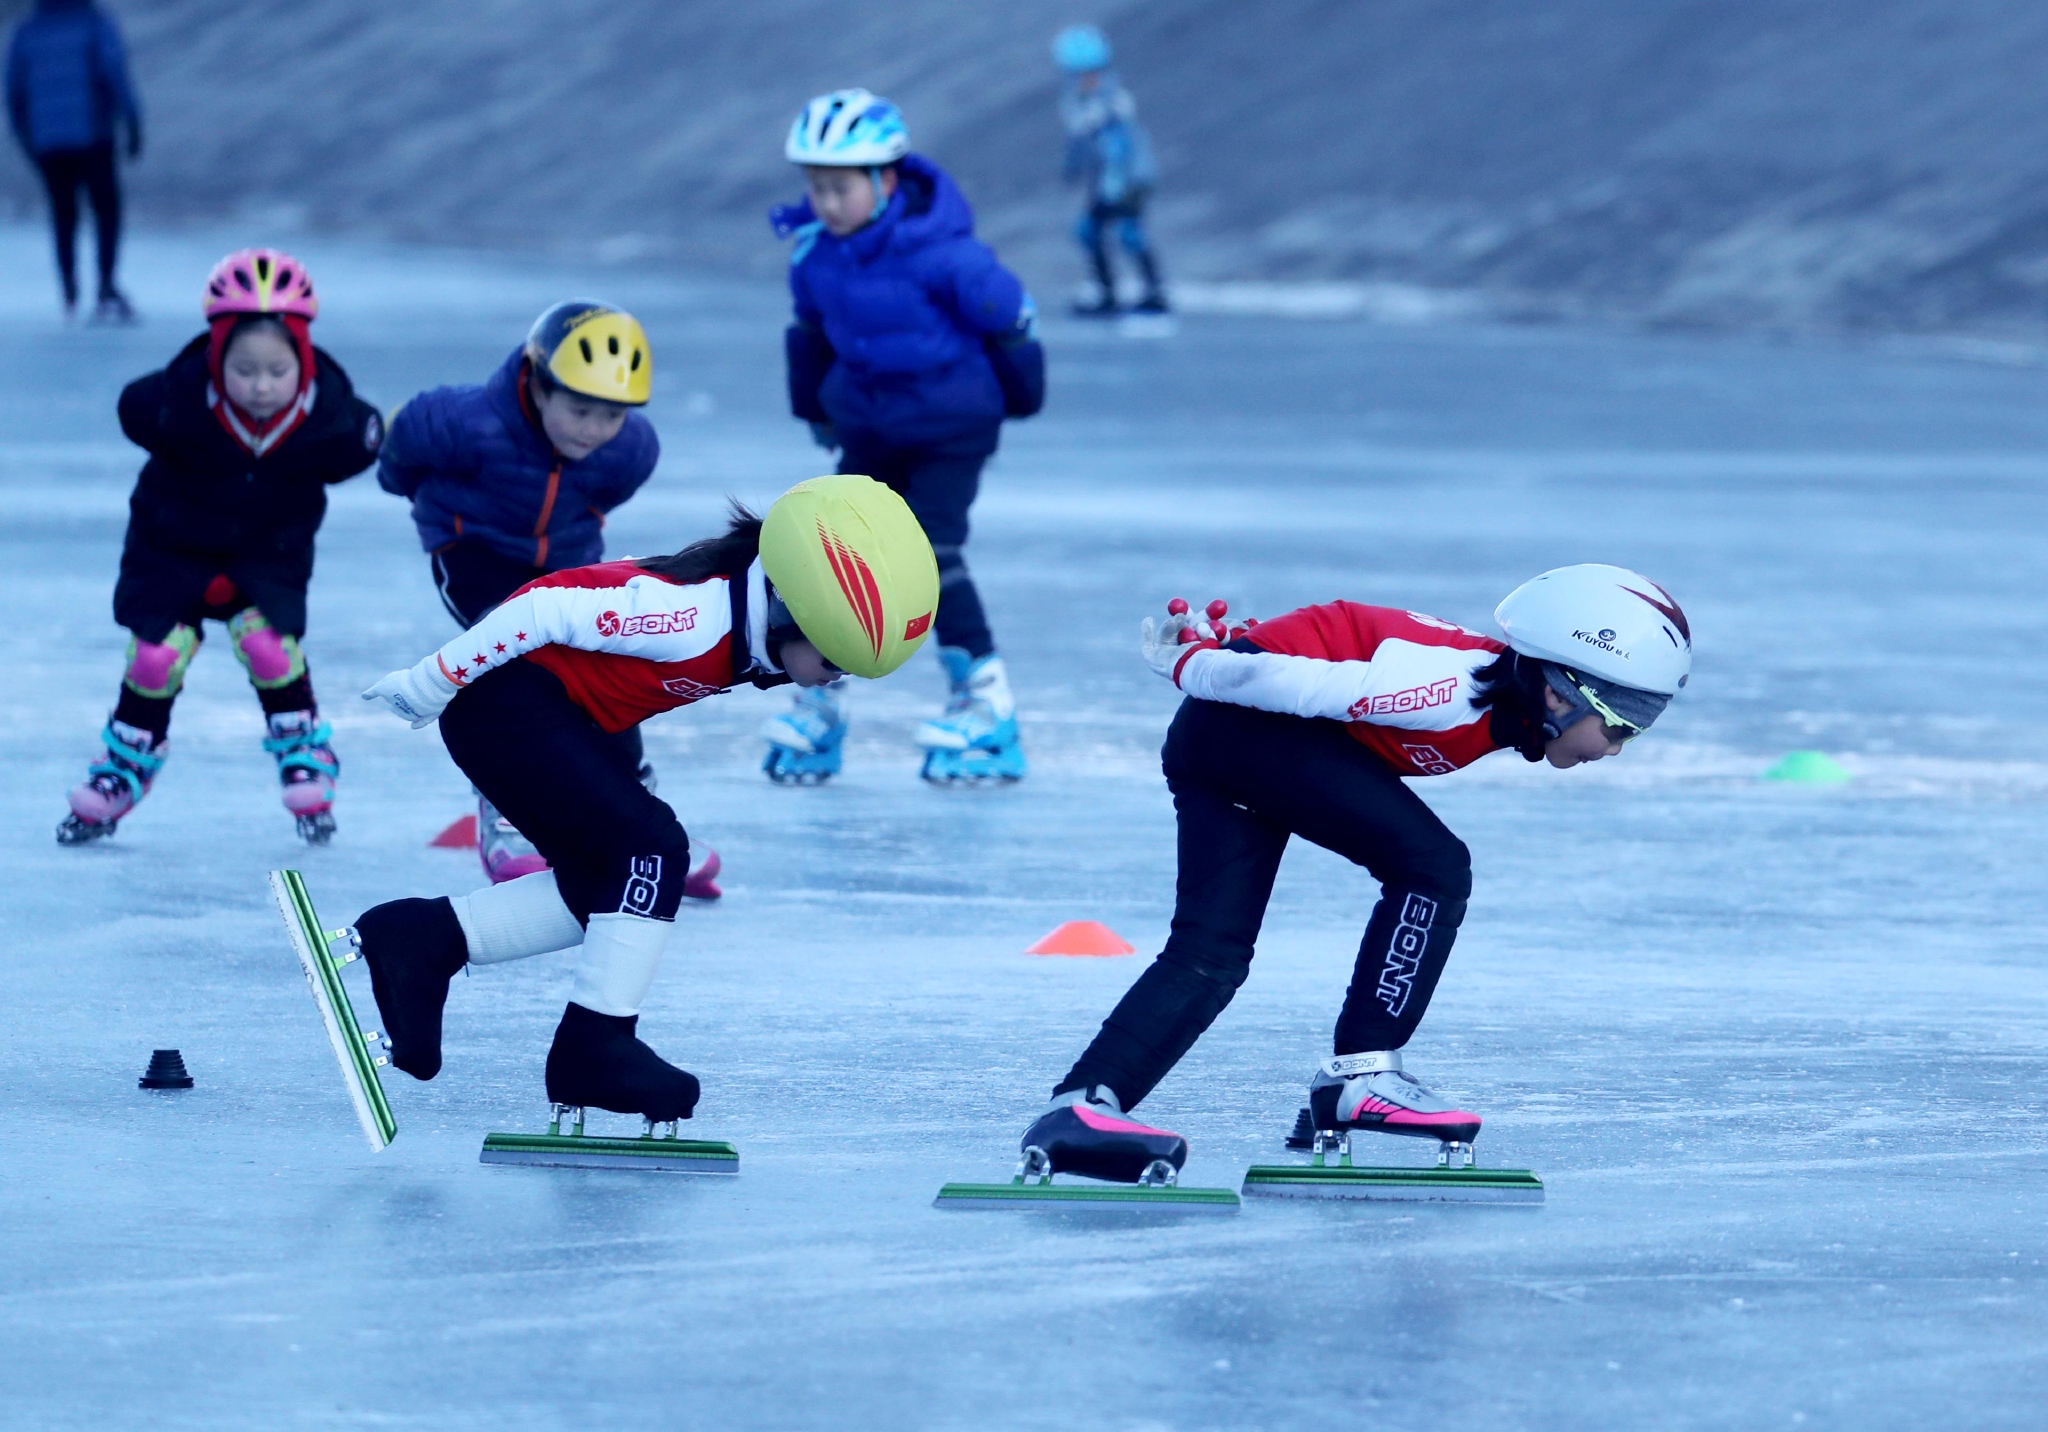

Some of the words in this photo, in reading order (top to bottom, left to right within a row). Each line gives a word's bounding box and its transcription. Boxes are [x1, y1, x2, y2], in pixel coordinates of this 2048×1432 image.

[620, 607, 698, 636] BONT
[1571, 629, 1615, 651] KUYOU
[1370, 677, 1457, 715] BONT
[1376, 892, 1438, 1017] BONT
